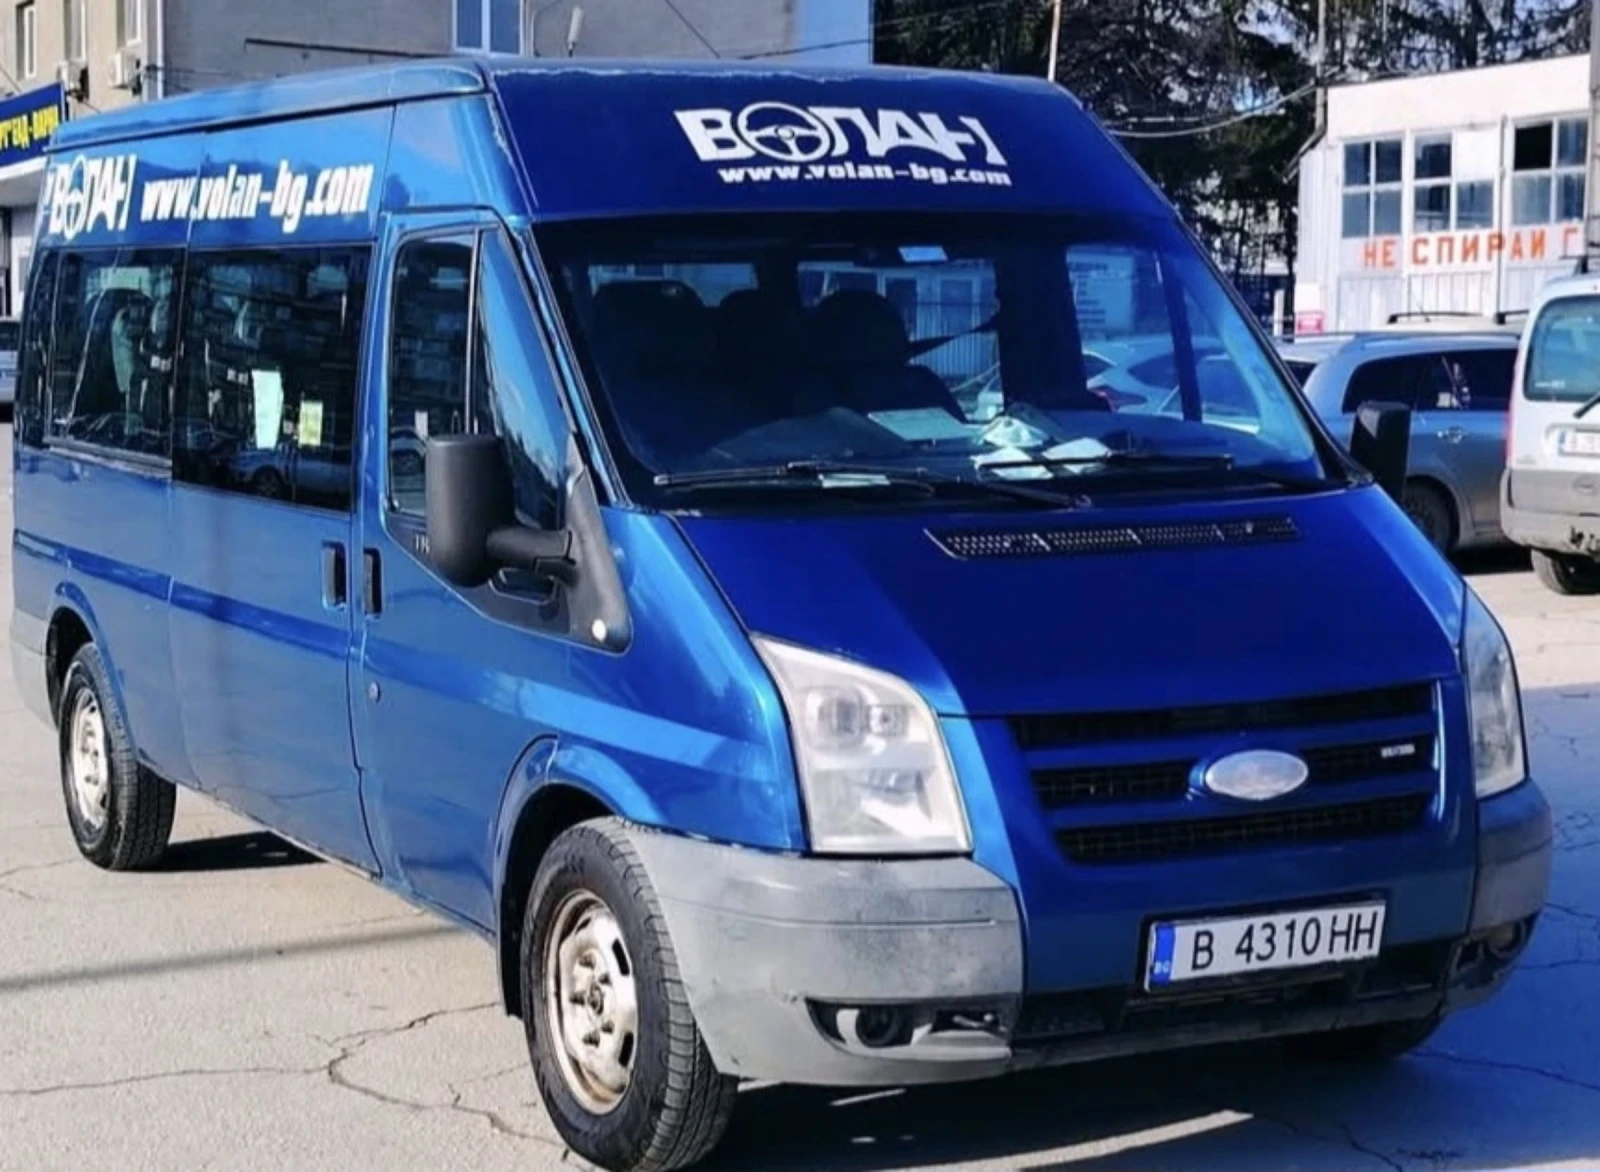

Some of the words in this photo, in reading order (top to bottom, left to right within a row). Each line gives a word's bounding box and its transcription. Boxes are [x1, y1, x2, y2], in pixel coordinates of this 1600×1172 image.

[717, 161, 1013, 187] www.volan-bg.com
[140, 158, 374, 233] www.volan-bg.com
[1364, 239, 1397, 269] НЕ
[1191, 930, 1214, 971] B
